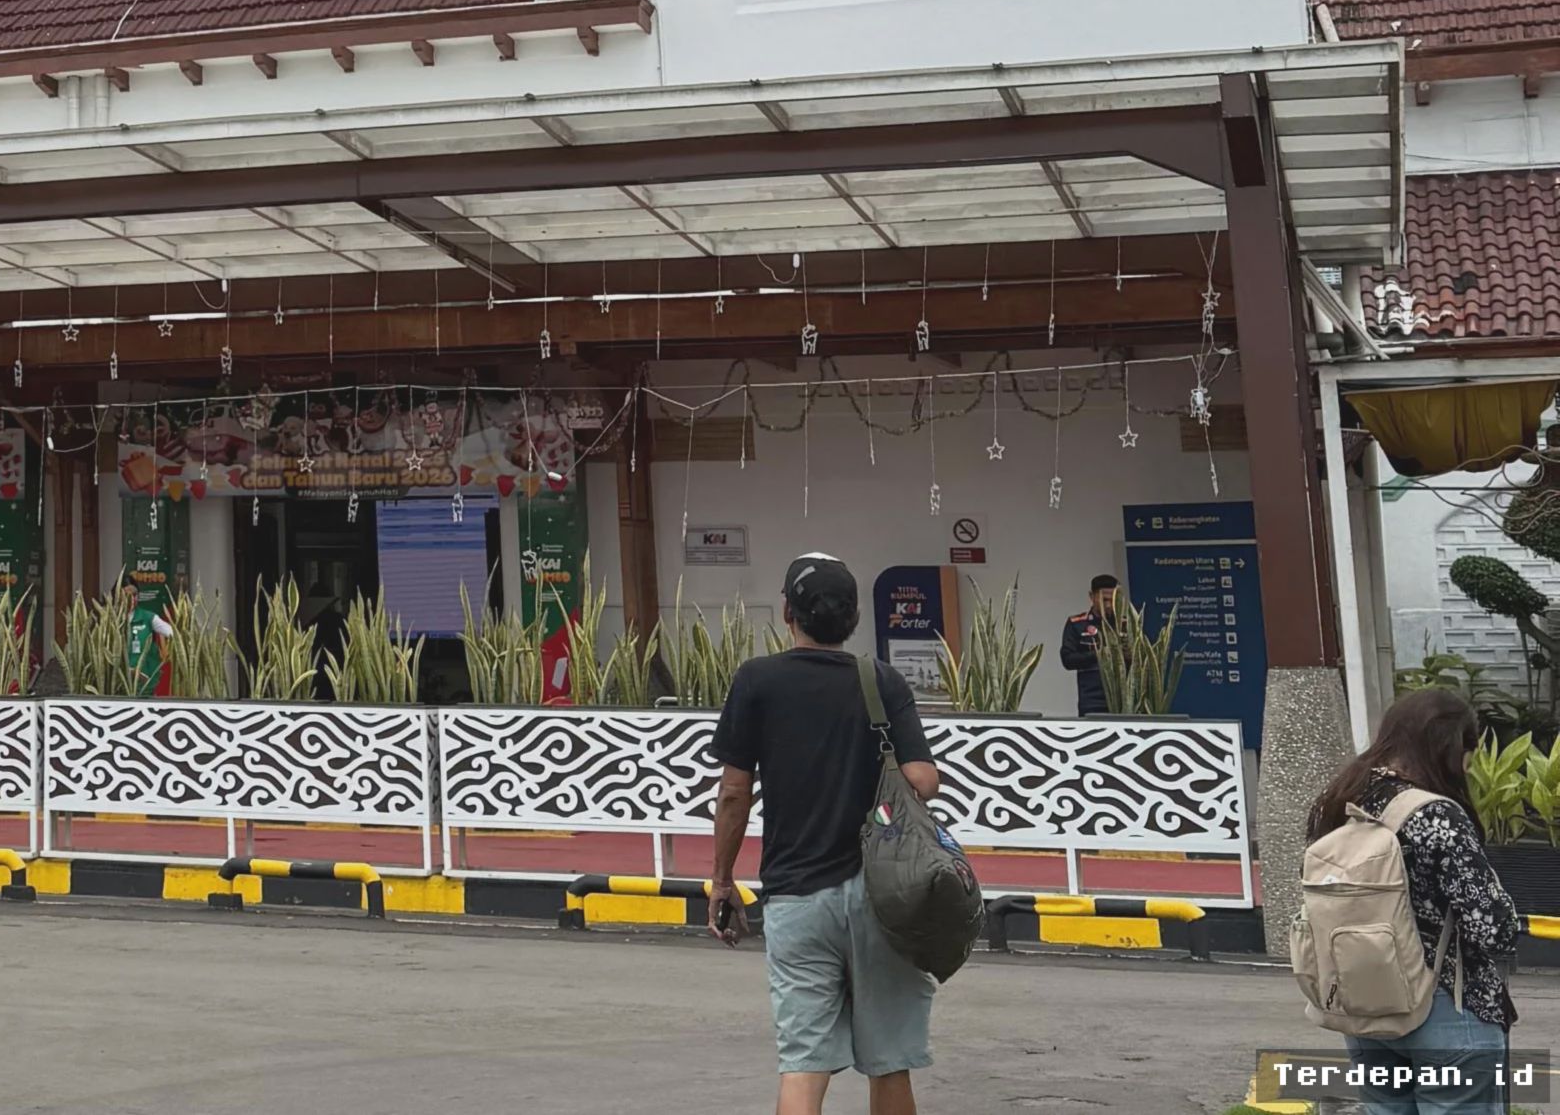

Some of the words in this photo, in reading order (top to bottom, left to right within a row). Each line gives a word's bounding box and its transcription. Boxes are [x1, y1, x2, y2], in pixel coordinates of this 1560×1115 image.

[242, 471, 281, 488] dan
[283, 470, 346, 487] Tahun
[348, 469, 399, 486] Baru
[400, 466, 454, 486] 2026
[136, 560, 158, 572] KAI
[888, 614, 931, 629] Porter
